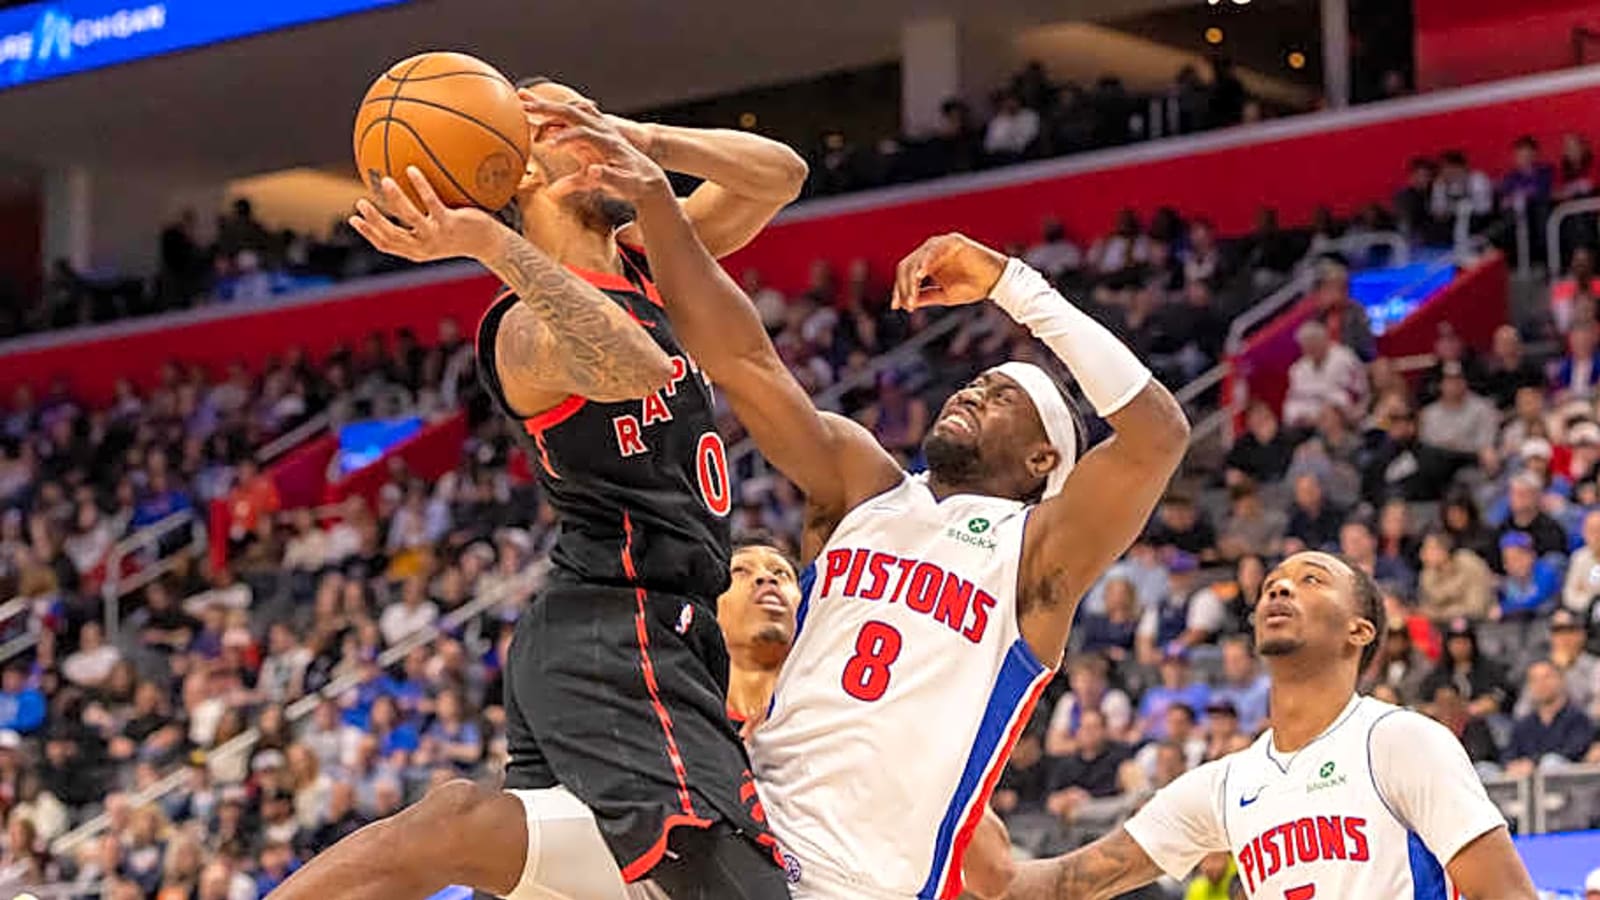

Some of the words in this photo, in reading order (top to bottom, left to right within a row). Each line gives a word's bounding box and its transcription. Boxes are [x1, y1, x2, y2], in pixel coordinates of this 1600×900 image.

[697, 432, 731, 517] 0
[820, 548, 997, 643] PISTONS
[841, 620, 902, 701] 8
[1238, 815, 1369, 894] PISTONS
